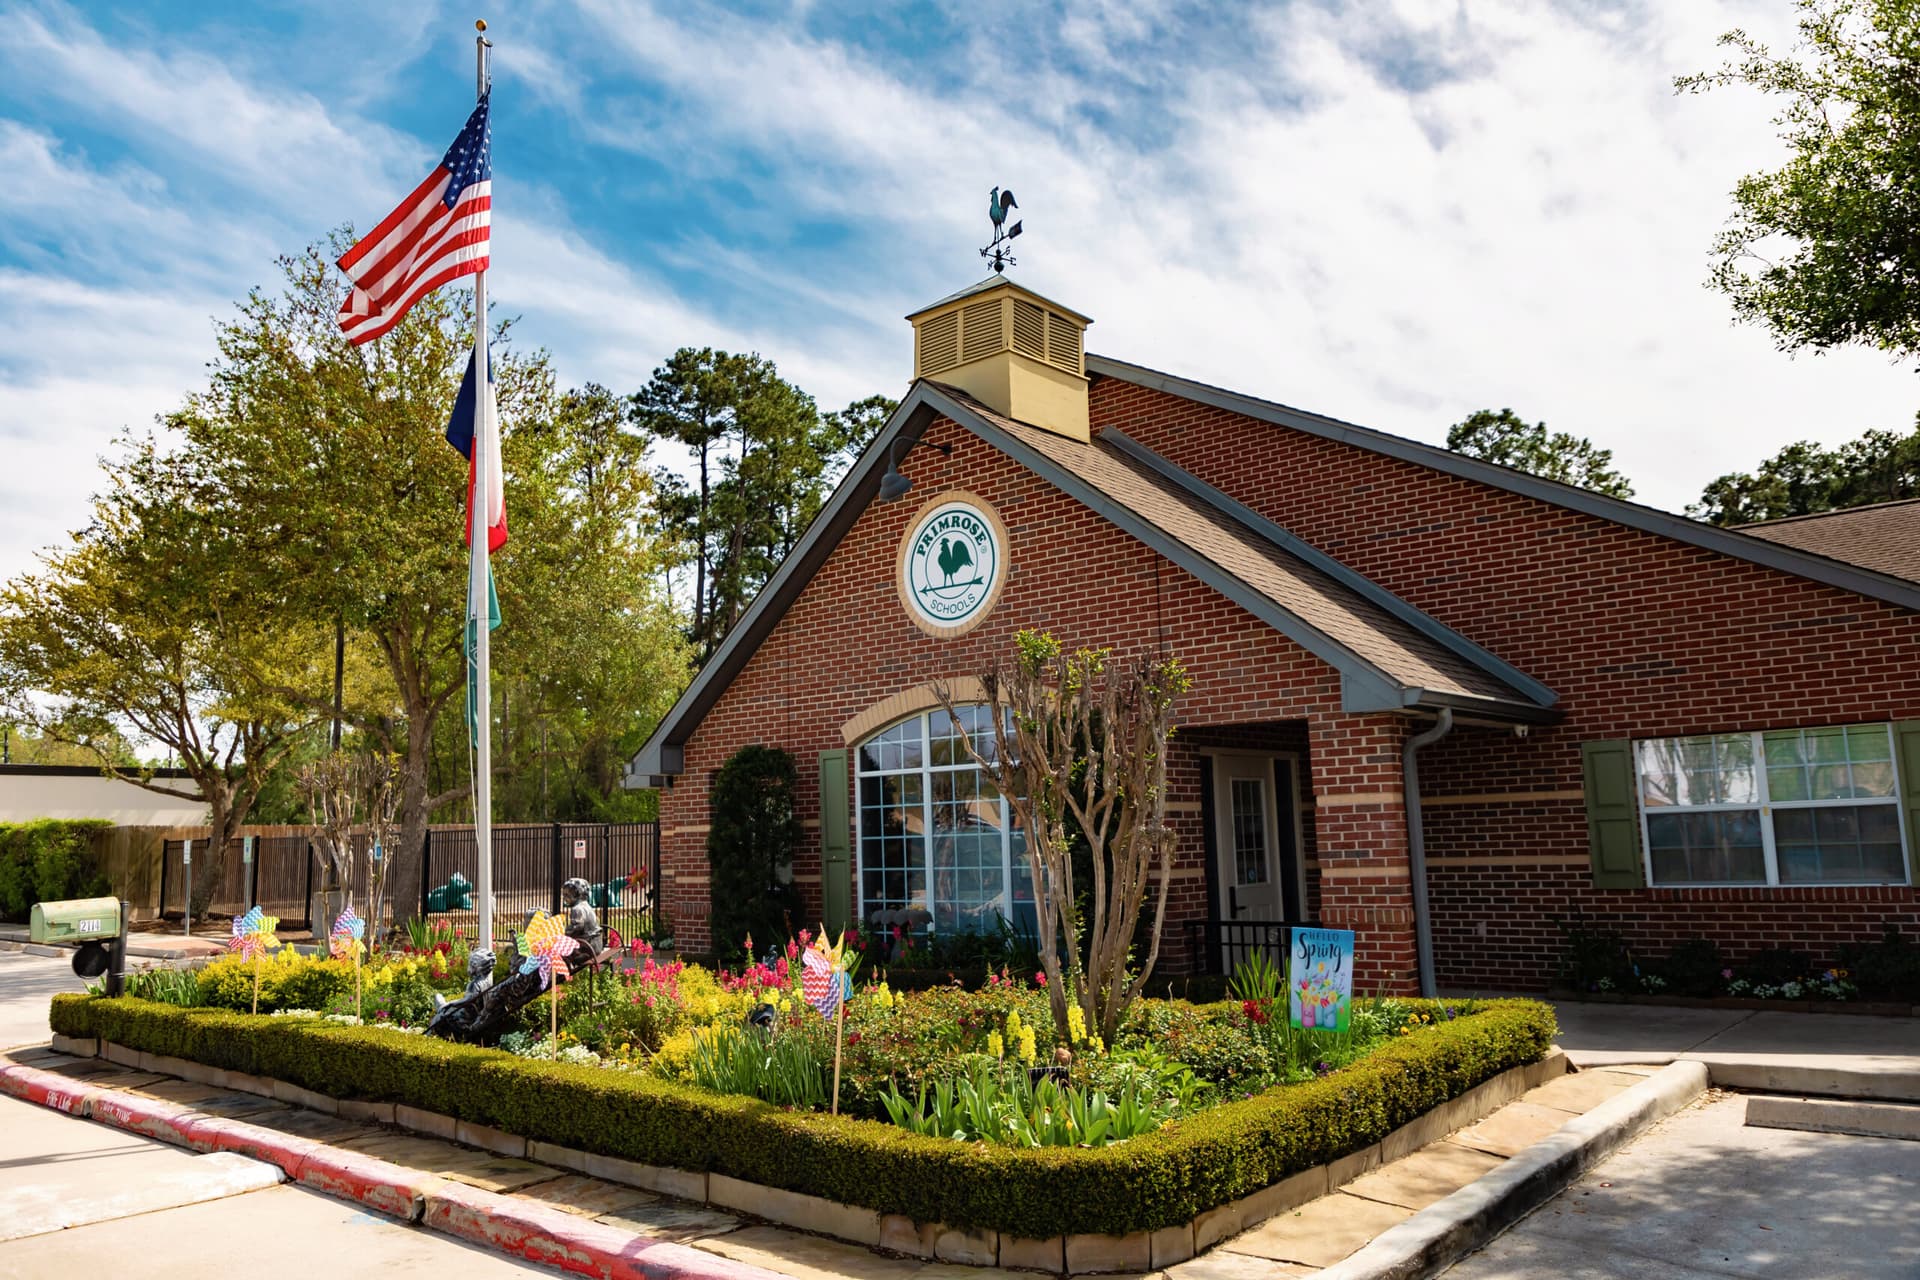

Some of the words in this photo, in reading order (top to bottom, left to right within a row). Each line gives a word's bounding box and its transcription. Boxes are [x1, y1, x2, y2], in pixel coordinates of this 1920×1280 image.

[916, 515, 987, 557] PRIMROSE
[930, 593, 976, 614] SCHOOLS
[1297, 932, 1342, 973] Spring
